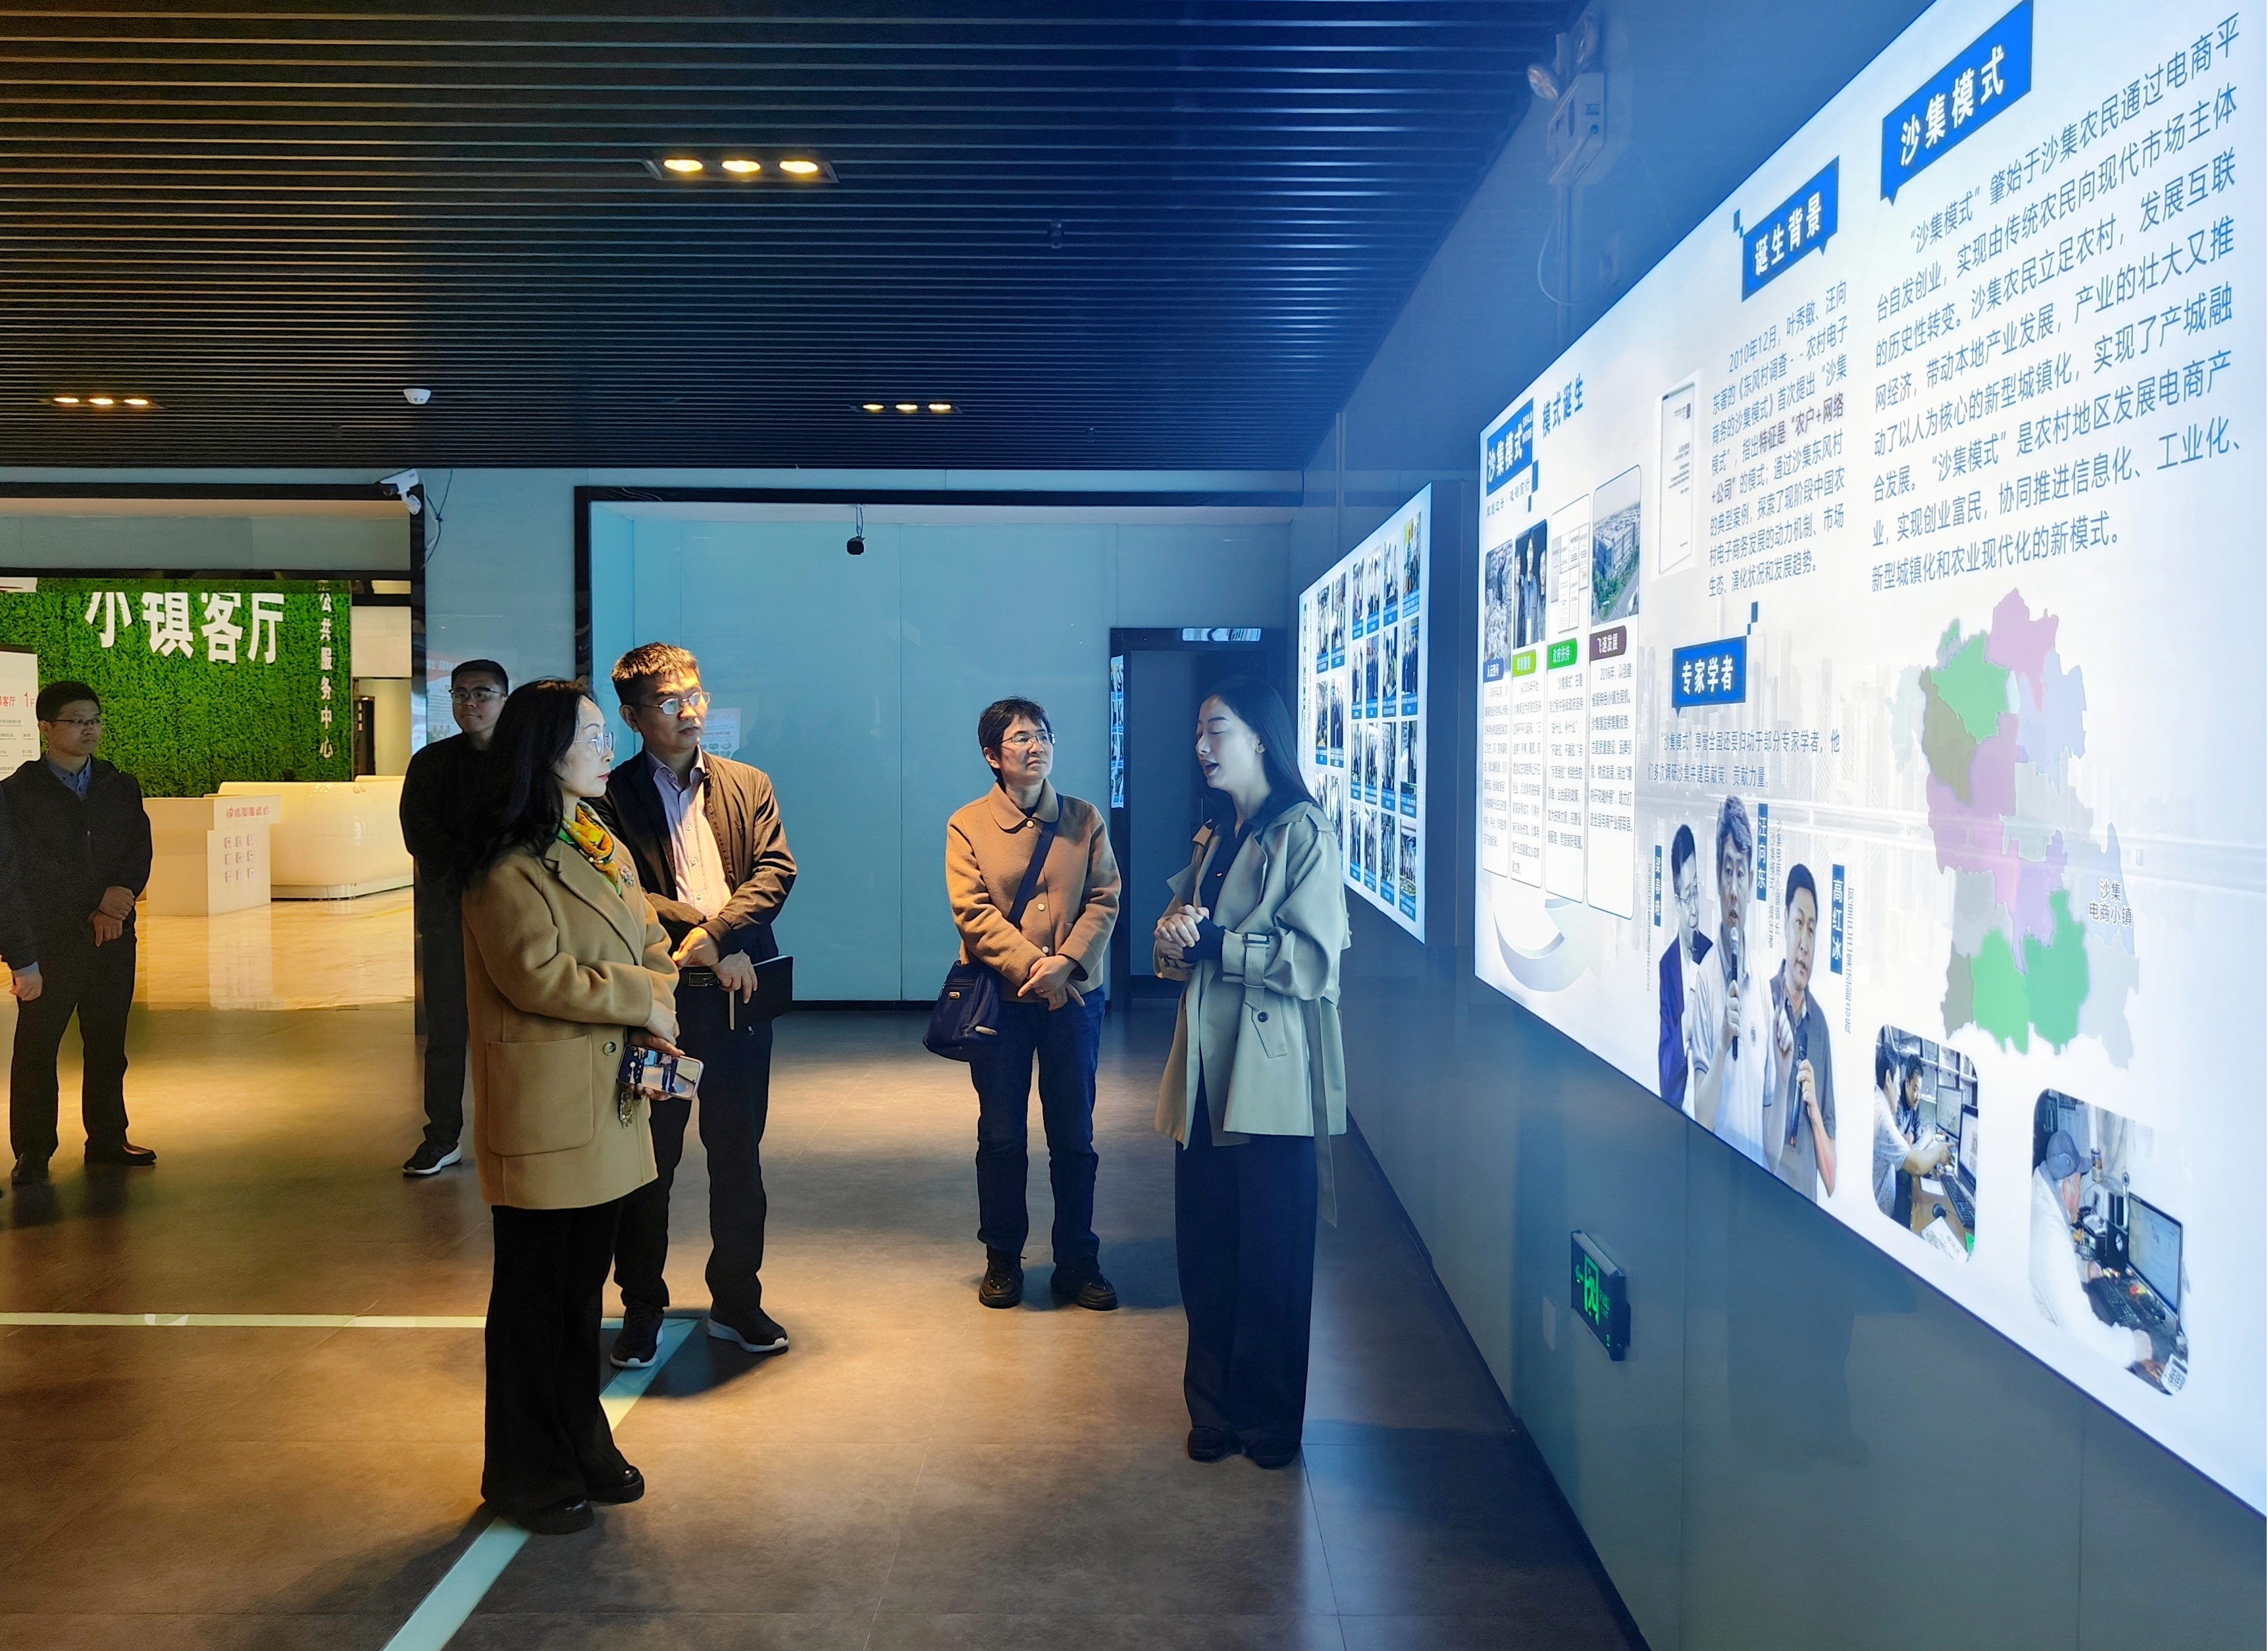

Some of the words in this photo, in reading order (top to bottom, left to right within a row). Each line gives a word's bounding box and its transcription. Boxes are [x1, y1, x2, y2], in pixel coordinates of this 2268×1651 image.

[1900, 44, 2005, 167] 沙集模式
[1755, 190, 1822, 276] 诞生背景
[1542, 372, 1584, 439] 模式诞生
[1487, 421, 1524, 483] 沙集模式
[84, 591, 285, 664] 小镇客厅
[320, 592, 334, 759] 公共服务中心
[1682, 654, 1734, 695] 专家学者
[1757, 816, 1767, 889] 汪向东
[1831, 878, 1843, 960] 高红冰
[2089, 902, 2132, 927] 电商小镇
[2100, 880, 2121, 901] 沙集
